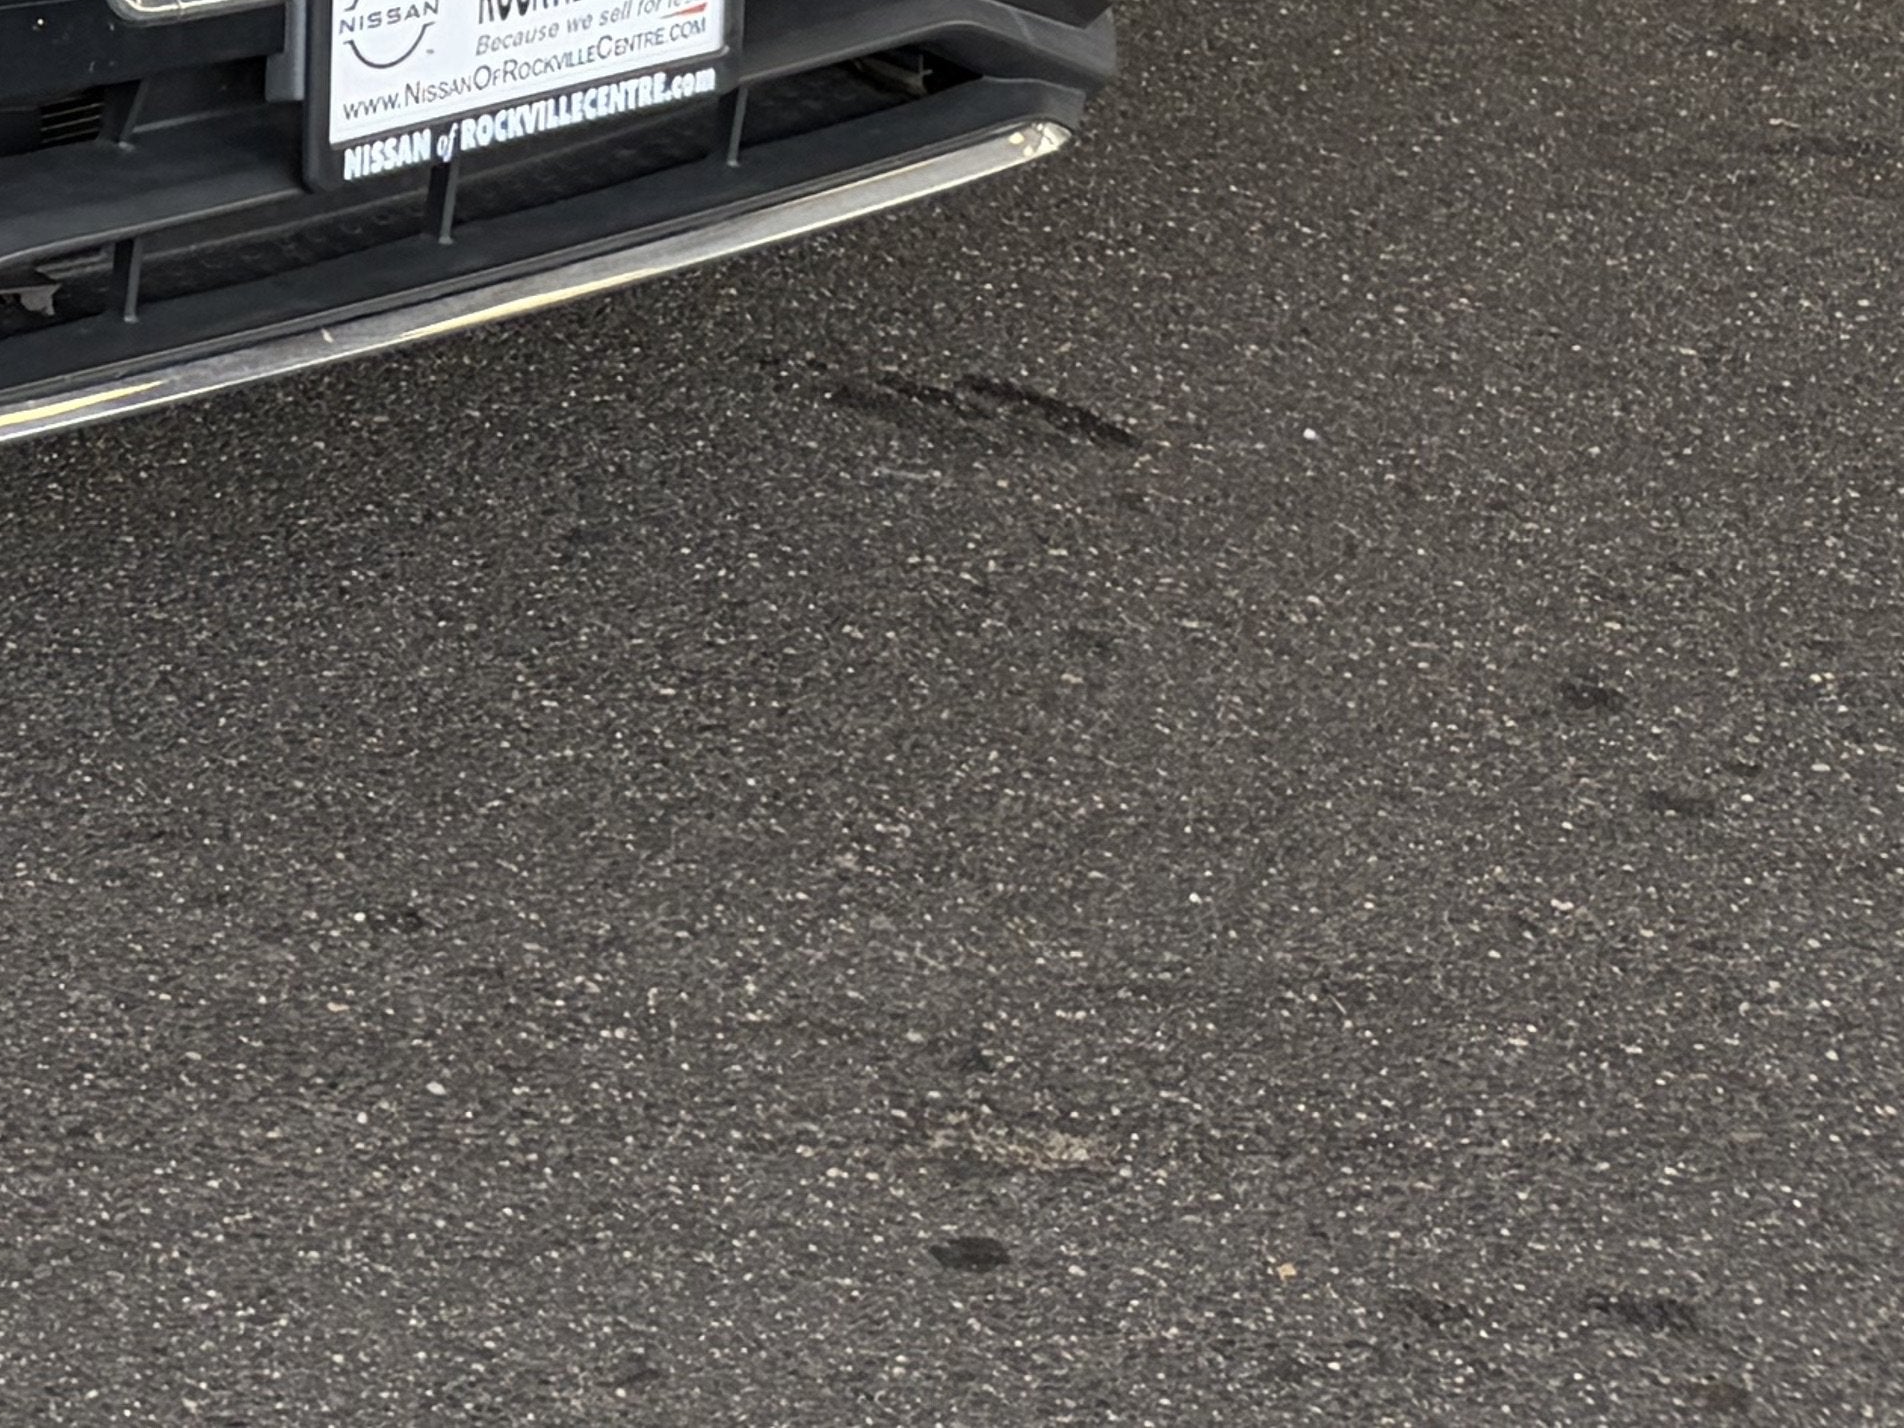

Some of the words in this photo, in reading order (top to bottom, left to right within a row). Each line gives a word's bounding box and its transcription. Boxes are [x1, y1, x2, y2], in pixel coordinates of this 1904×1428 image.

[476, 22, 559, 56] Because
[567, 14, 593, 34] we
[599, 0, 633, 26] sell
[343, 128, 431, 181] NISSAN
[435, 122, 460, 162] of
[460, 67, 716, 152] ROCKVILLECENTRE.com
